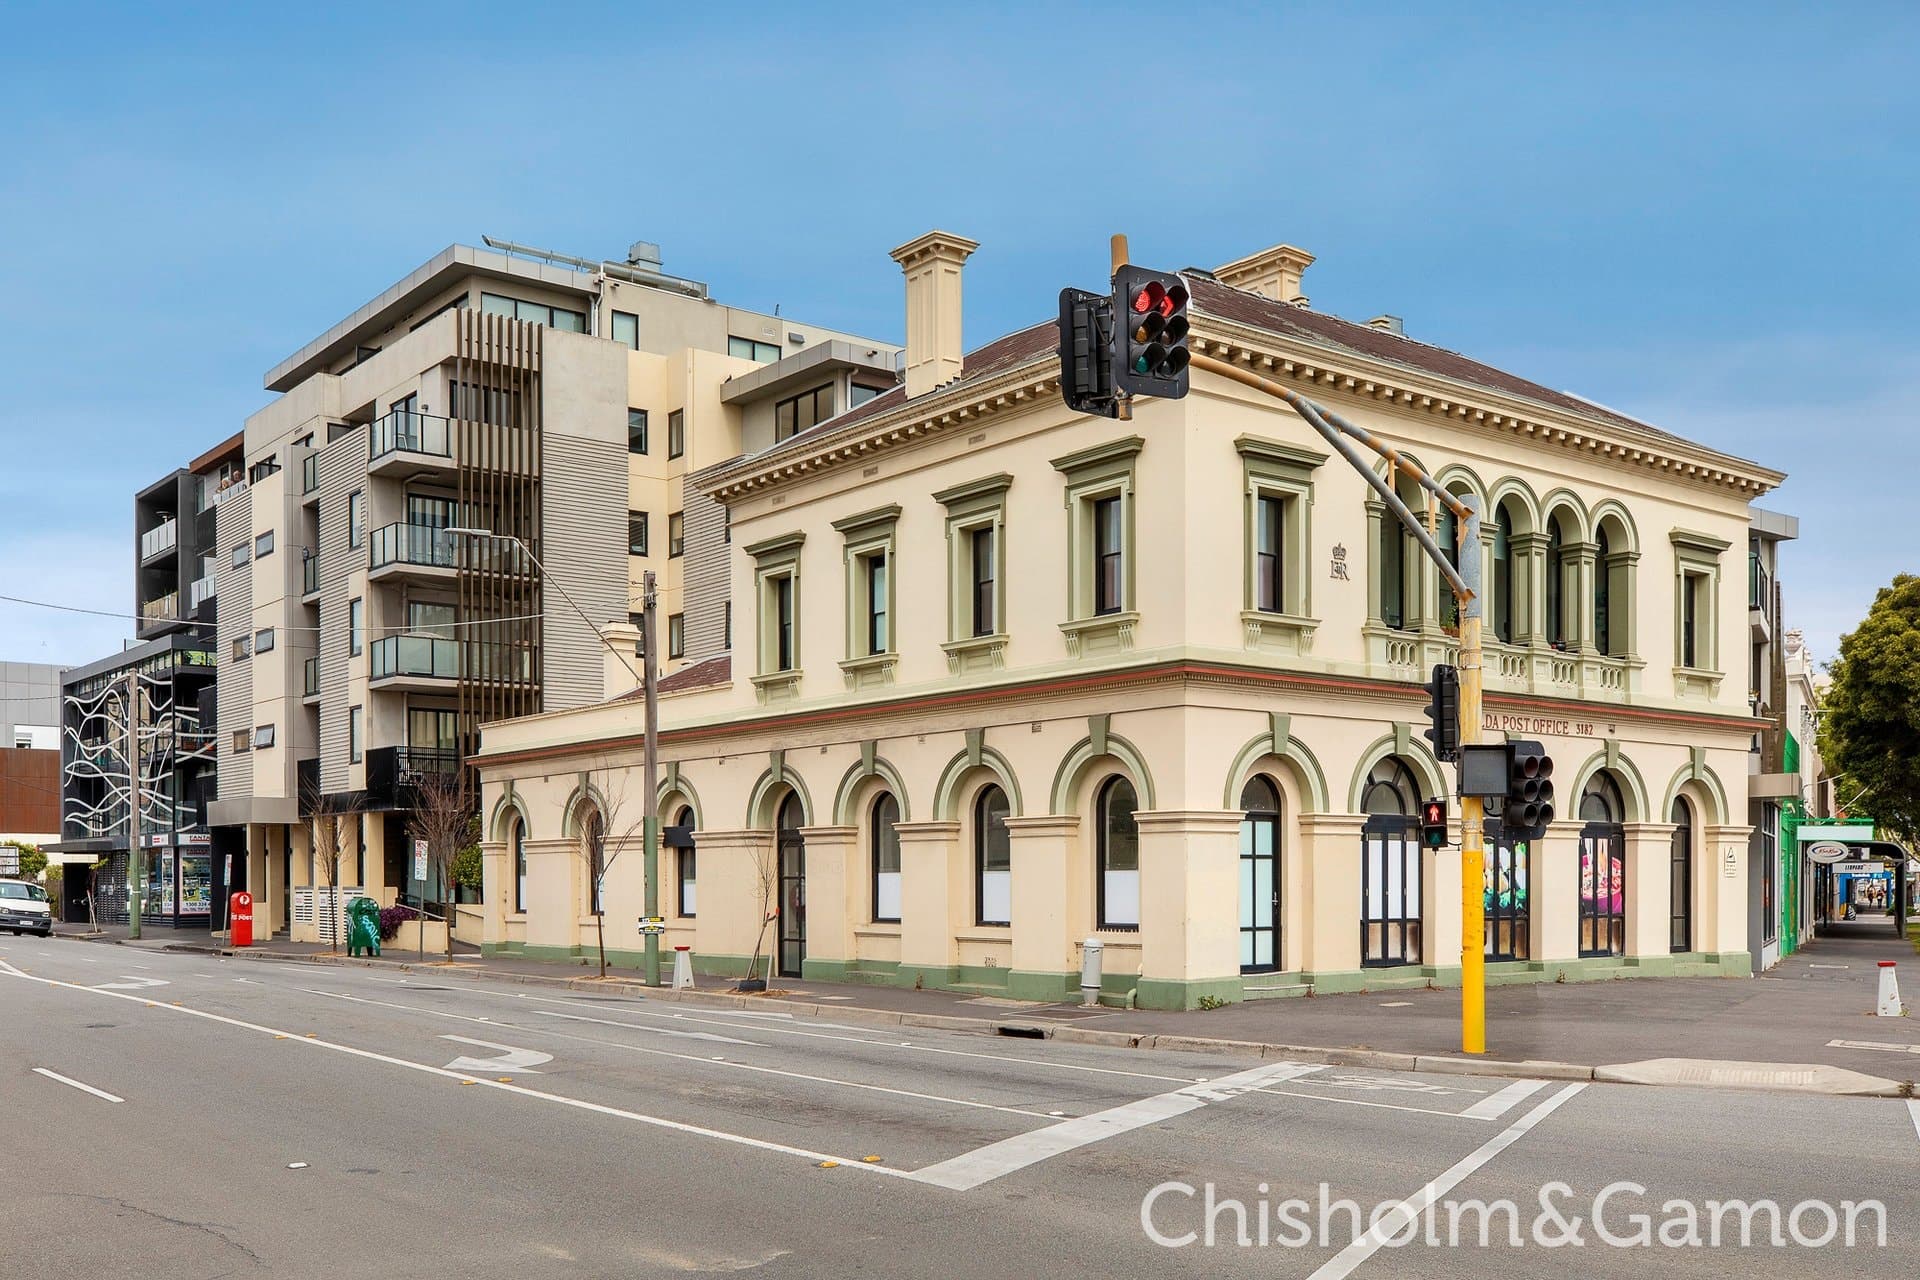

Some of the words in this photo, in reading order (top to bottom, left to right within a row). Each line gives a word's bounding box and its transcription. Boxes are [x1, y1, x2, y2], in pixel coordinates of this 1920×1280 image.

[1502, 715, 1530, 731] POST
[1532, 718, 1569, 735] OFFICE
[1575, 723, 1594, 736] 3182
